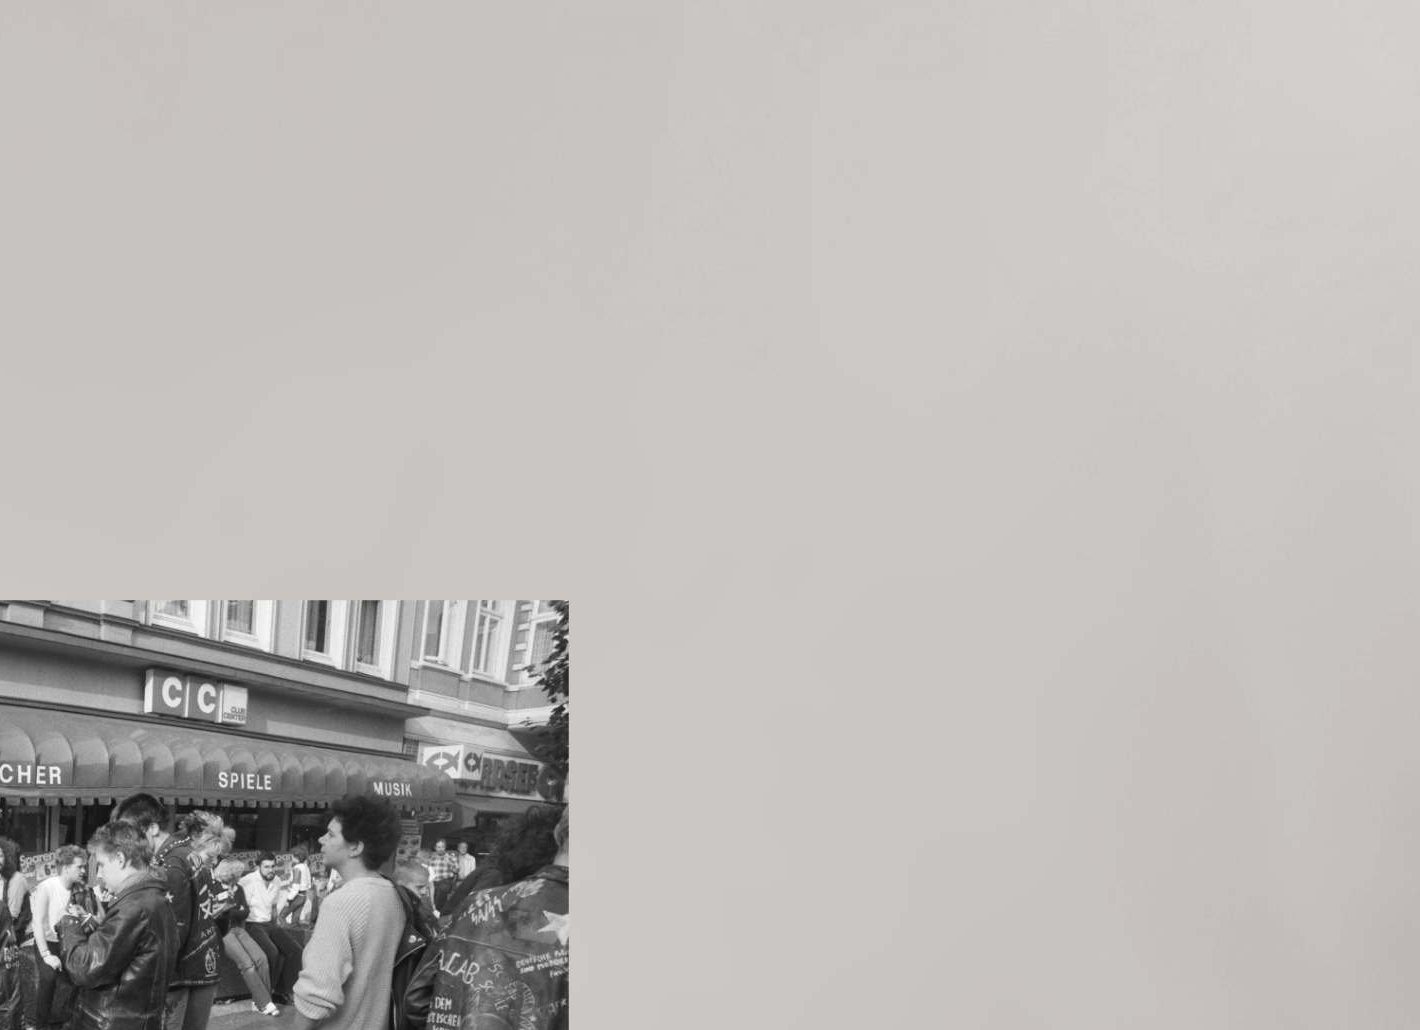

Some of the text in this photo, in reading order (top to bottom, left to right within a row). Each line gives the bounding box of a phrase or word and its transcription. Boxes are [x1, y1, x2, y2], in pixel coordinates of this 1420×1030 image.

[218, 771, 272, 791] SPIELE
[372, 780, 413, 797] MUSIK
[435, 996, 452, 1011] DEM
